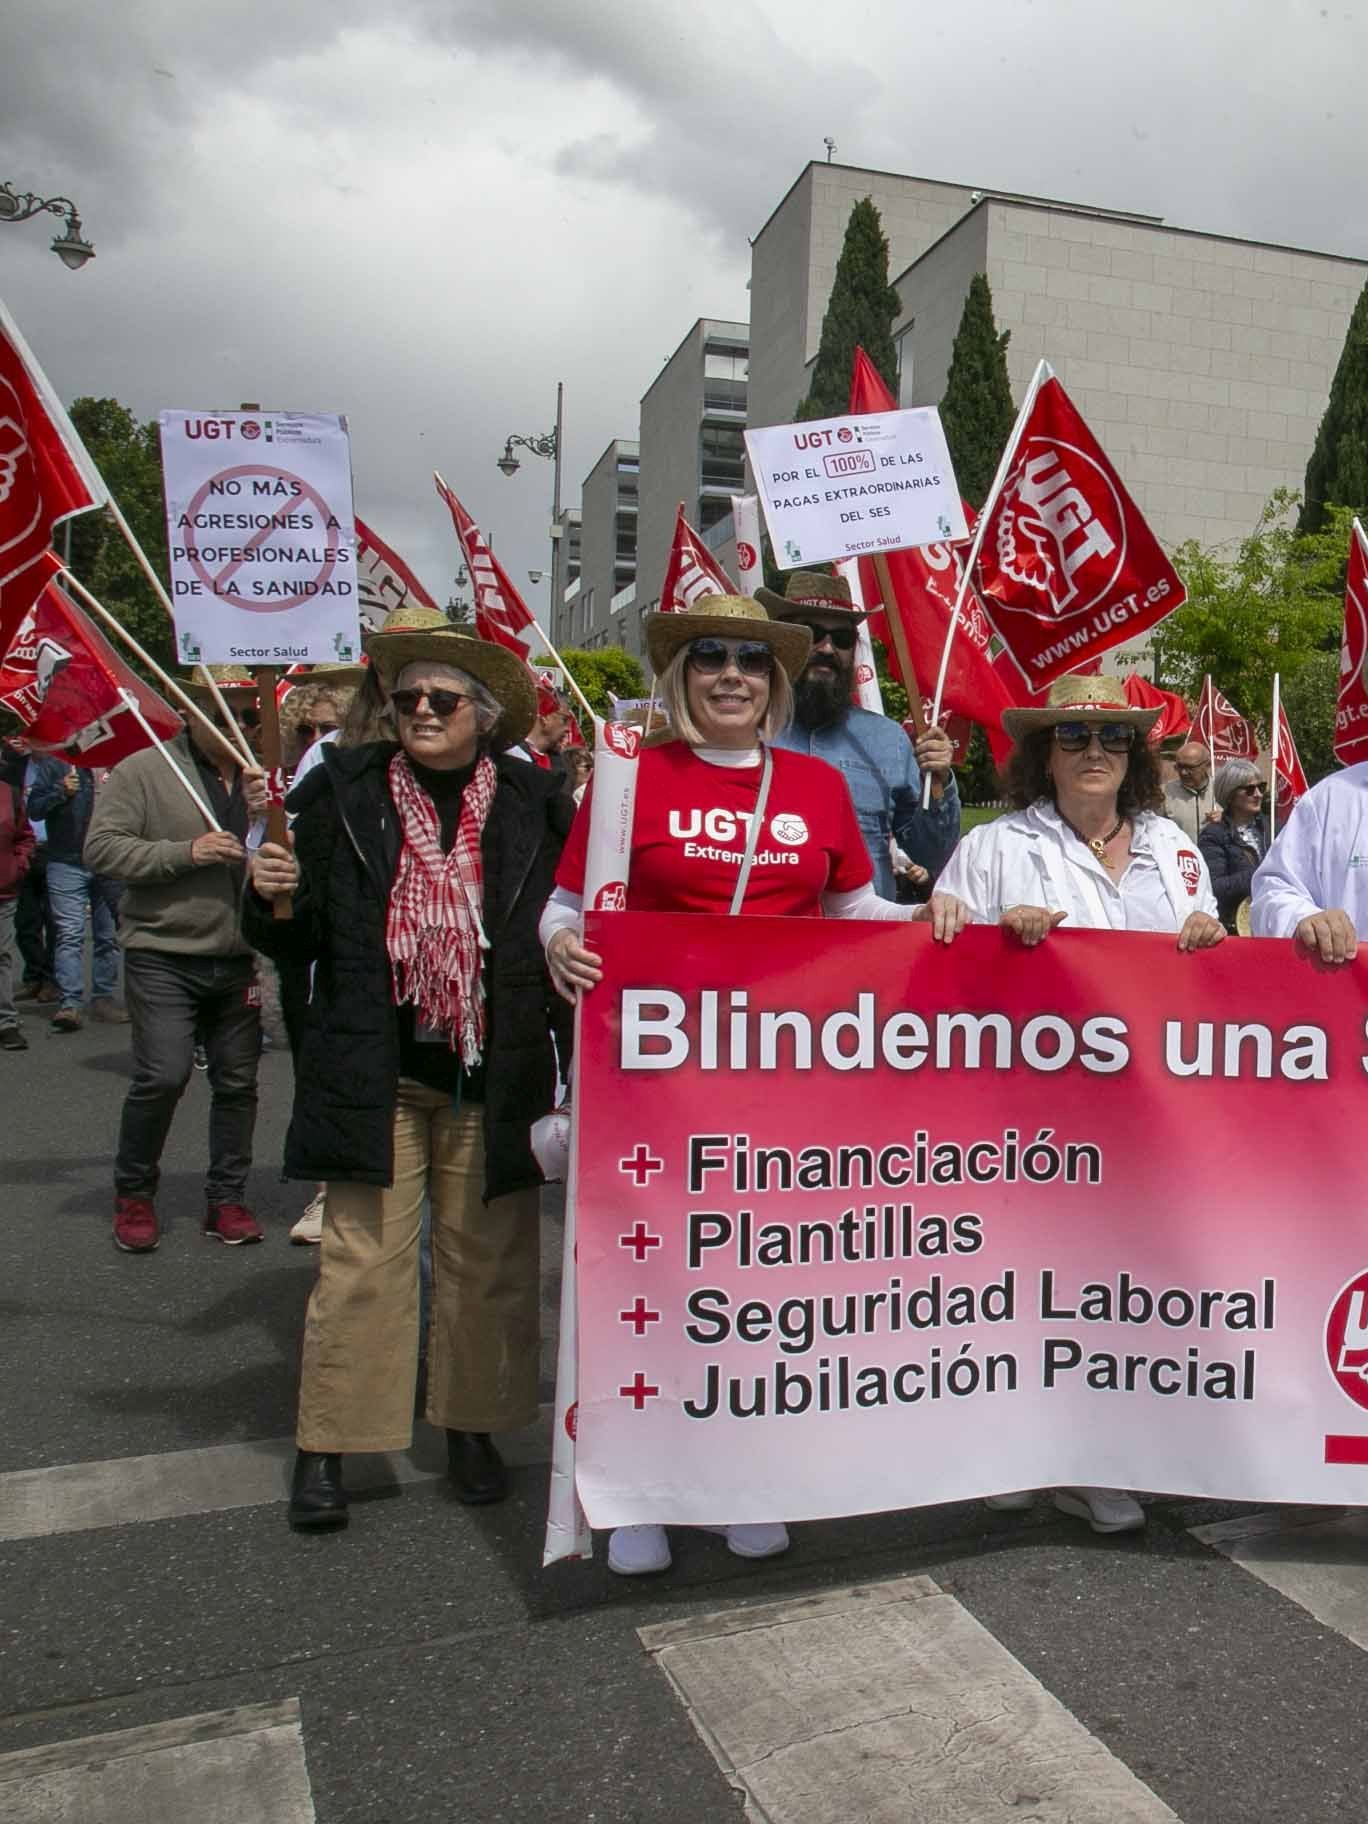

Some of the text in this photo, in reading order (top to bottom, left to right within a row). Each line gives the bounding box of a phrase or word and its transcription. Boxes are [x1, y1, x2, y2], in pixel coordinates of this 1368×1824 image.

[185, 419, 236, 440] UGT
[794, 429, 833, 450] UGT
[772, 452, 923, 484] POR EL 100% DE LAS
[209, 476, 303, 497] NO MÁS
[774, 475, 941, 510] PAGAS EXTRAORDINARIAS
[177, 513, 341, 530] AGRESIONES A
[840, 507, 891, 523] DEL SES
[1018, 450, 1116, 576] UGT
[173, 547, 350, 563] PROFESIONALES
[845, 535, 901, 552] Sector Salud
[175, 580, 352, 597] DE LA SANIDAD
[1032, 577, 1171, 670] www.UGT.es
[230, 646, 308, 658] Sector Salud
[669, 808, 765, 842] UGT
[619, 987, 1130, 1075] Blindemos
[1166, 1022, 1329, 1080] una
[687, 1129, 1103, 1193] Financiación
[687, 1205, 984, 1269] Plantillas
[684, 1270, 1016, 1354] Seguridad
[1039, 1271, 1276, 1331] Laboral
[682, 1344, 1017, 1420] Jubilación
[1042, 1338, 1256, 1400] Parcial
